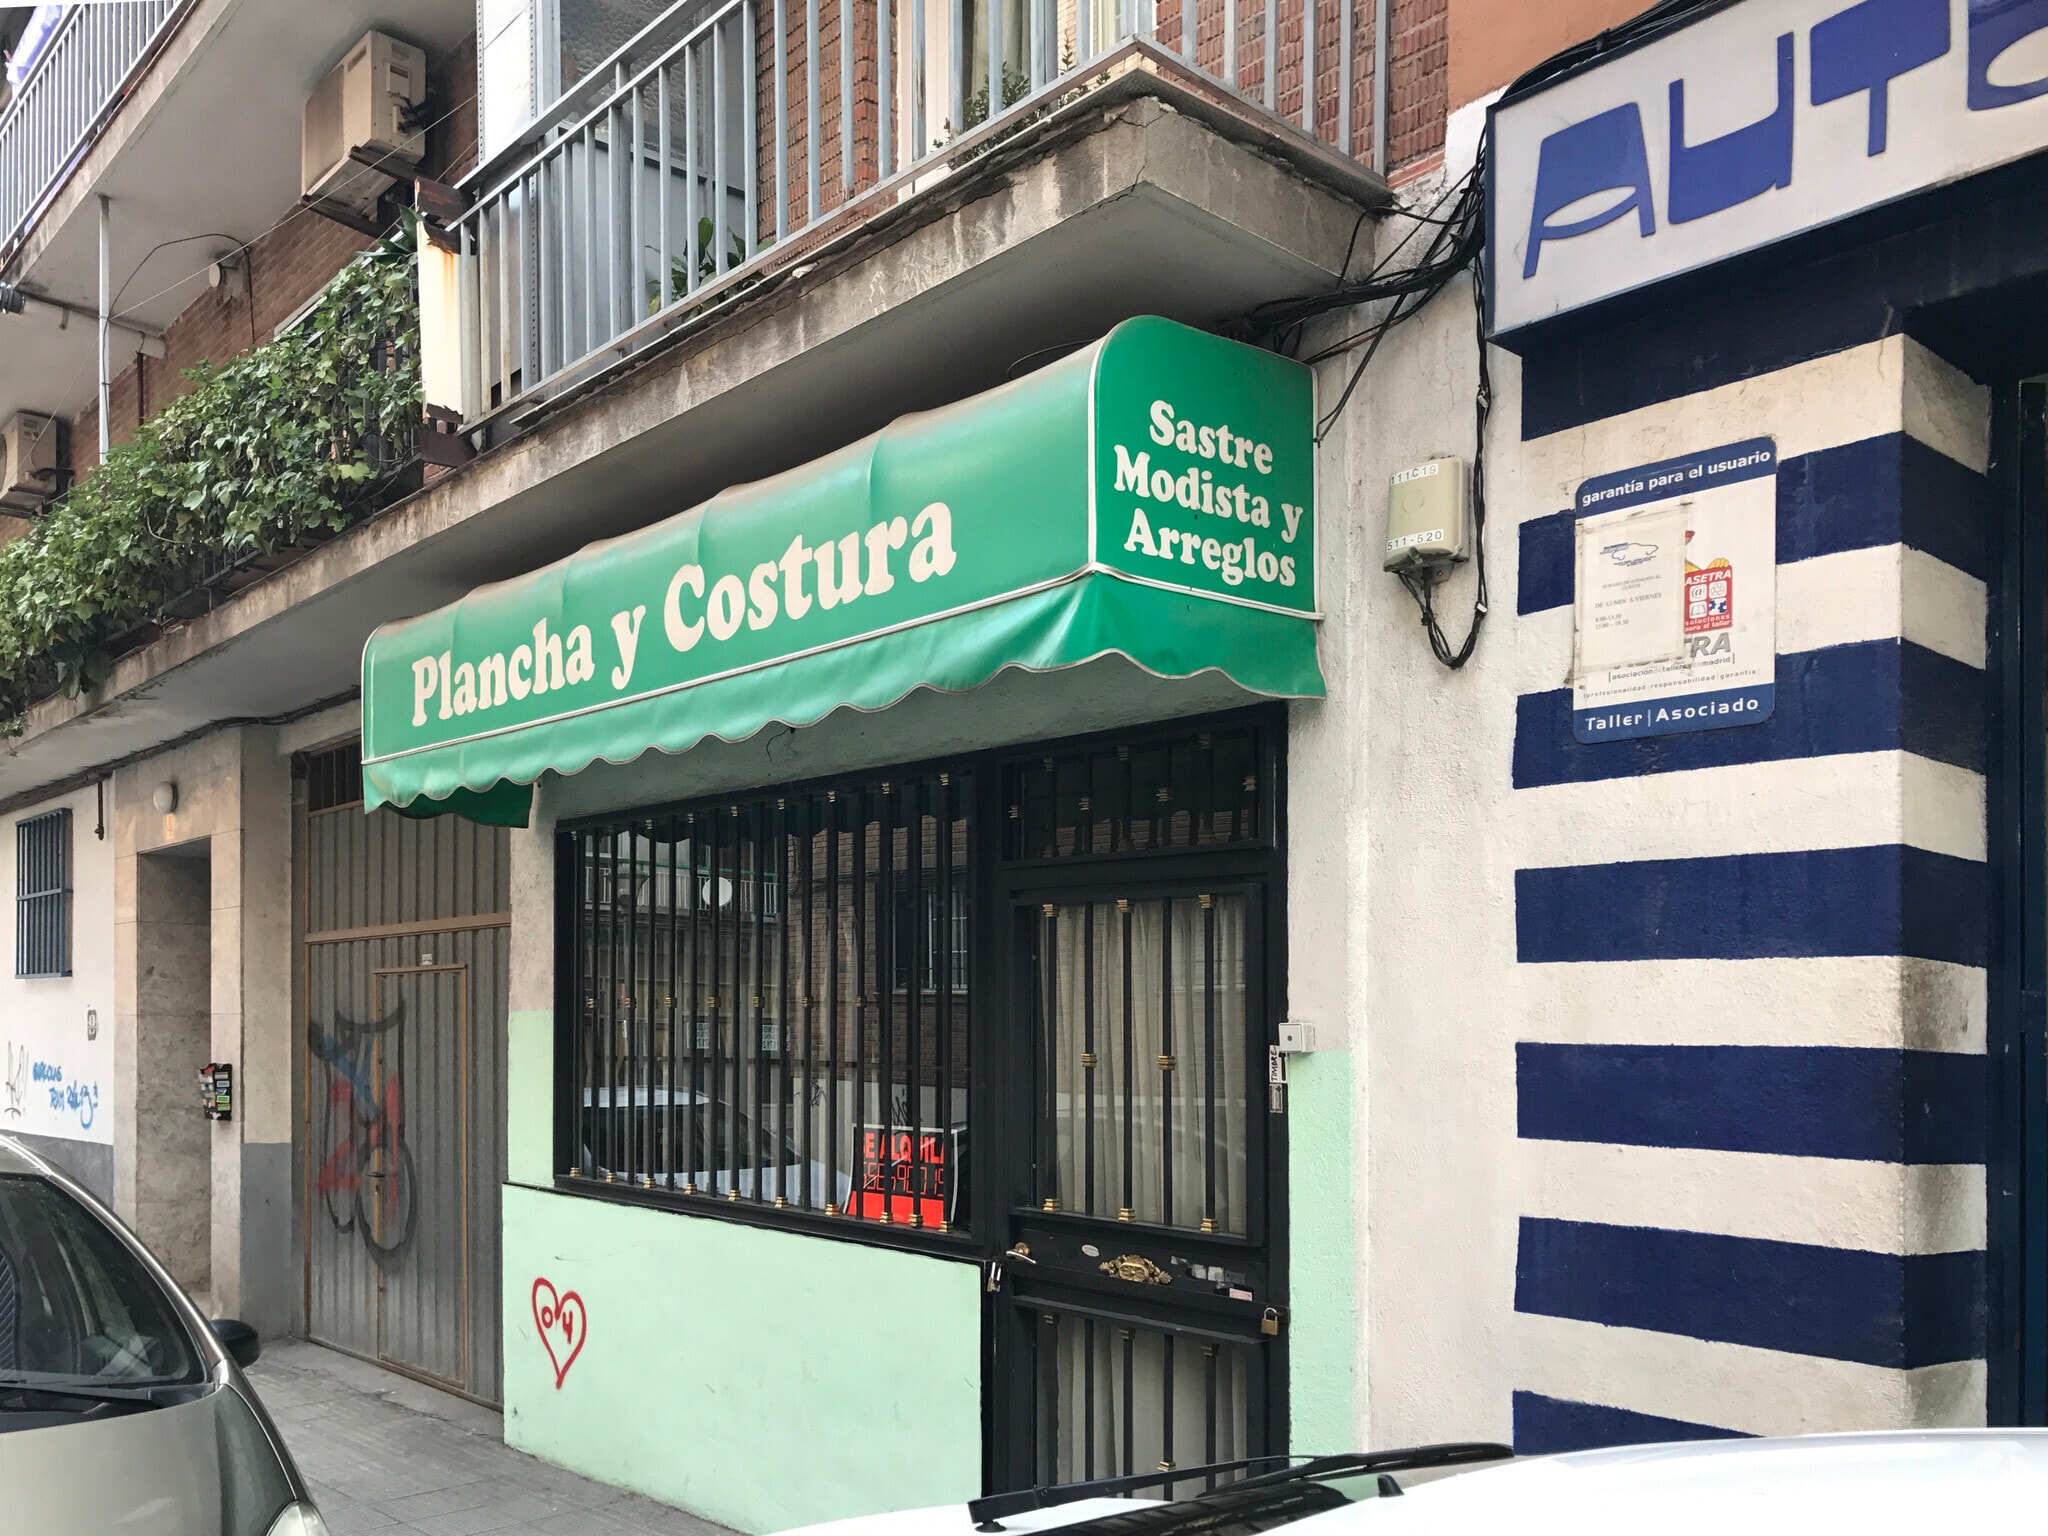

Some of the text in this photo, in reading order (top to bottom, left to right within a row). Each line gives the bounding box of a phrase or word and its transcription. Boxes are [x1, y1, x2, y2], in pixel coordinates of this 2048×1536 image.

[1149, 400, 1273, 474] Sastre
[1114, 444, 1304, 543] Modista y
[1582, 450, 1771, 507] garantía para el usuario
[1123, 508, 1296, 587] Arreglos
[1387, 530, 1442, 551] 511-520
[1684, 569, 1732, 586] ASETRA
[411, 501, 957, 728] Plancha y Costura
[1606, 599, 1626, 607] LUNES
[1635, 592, 1662, 602] VIERNES
[1685, 614, 1731, 626] soluciones
[1711, 619, 1731, 628] taller
